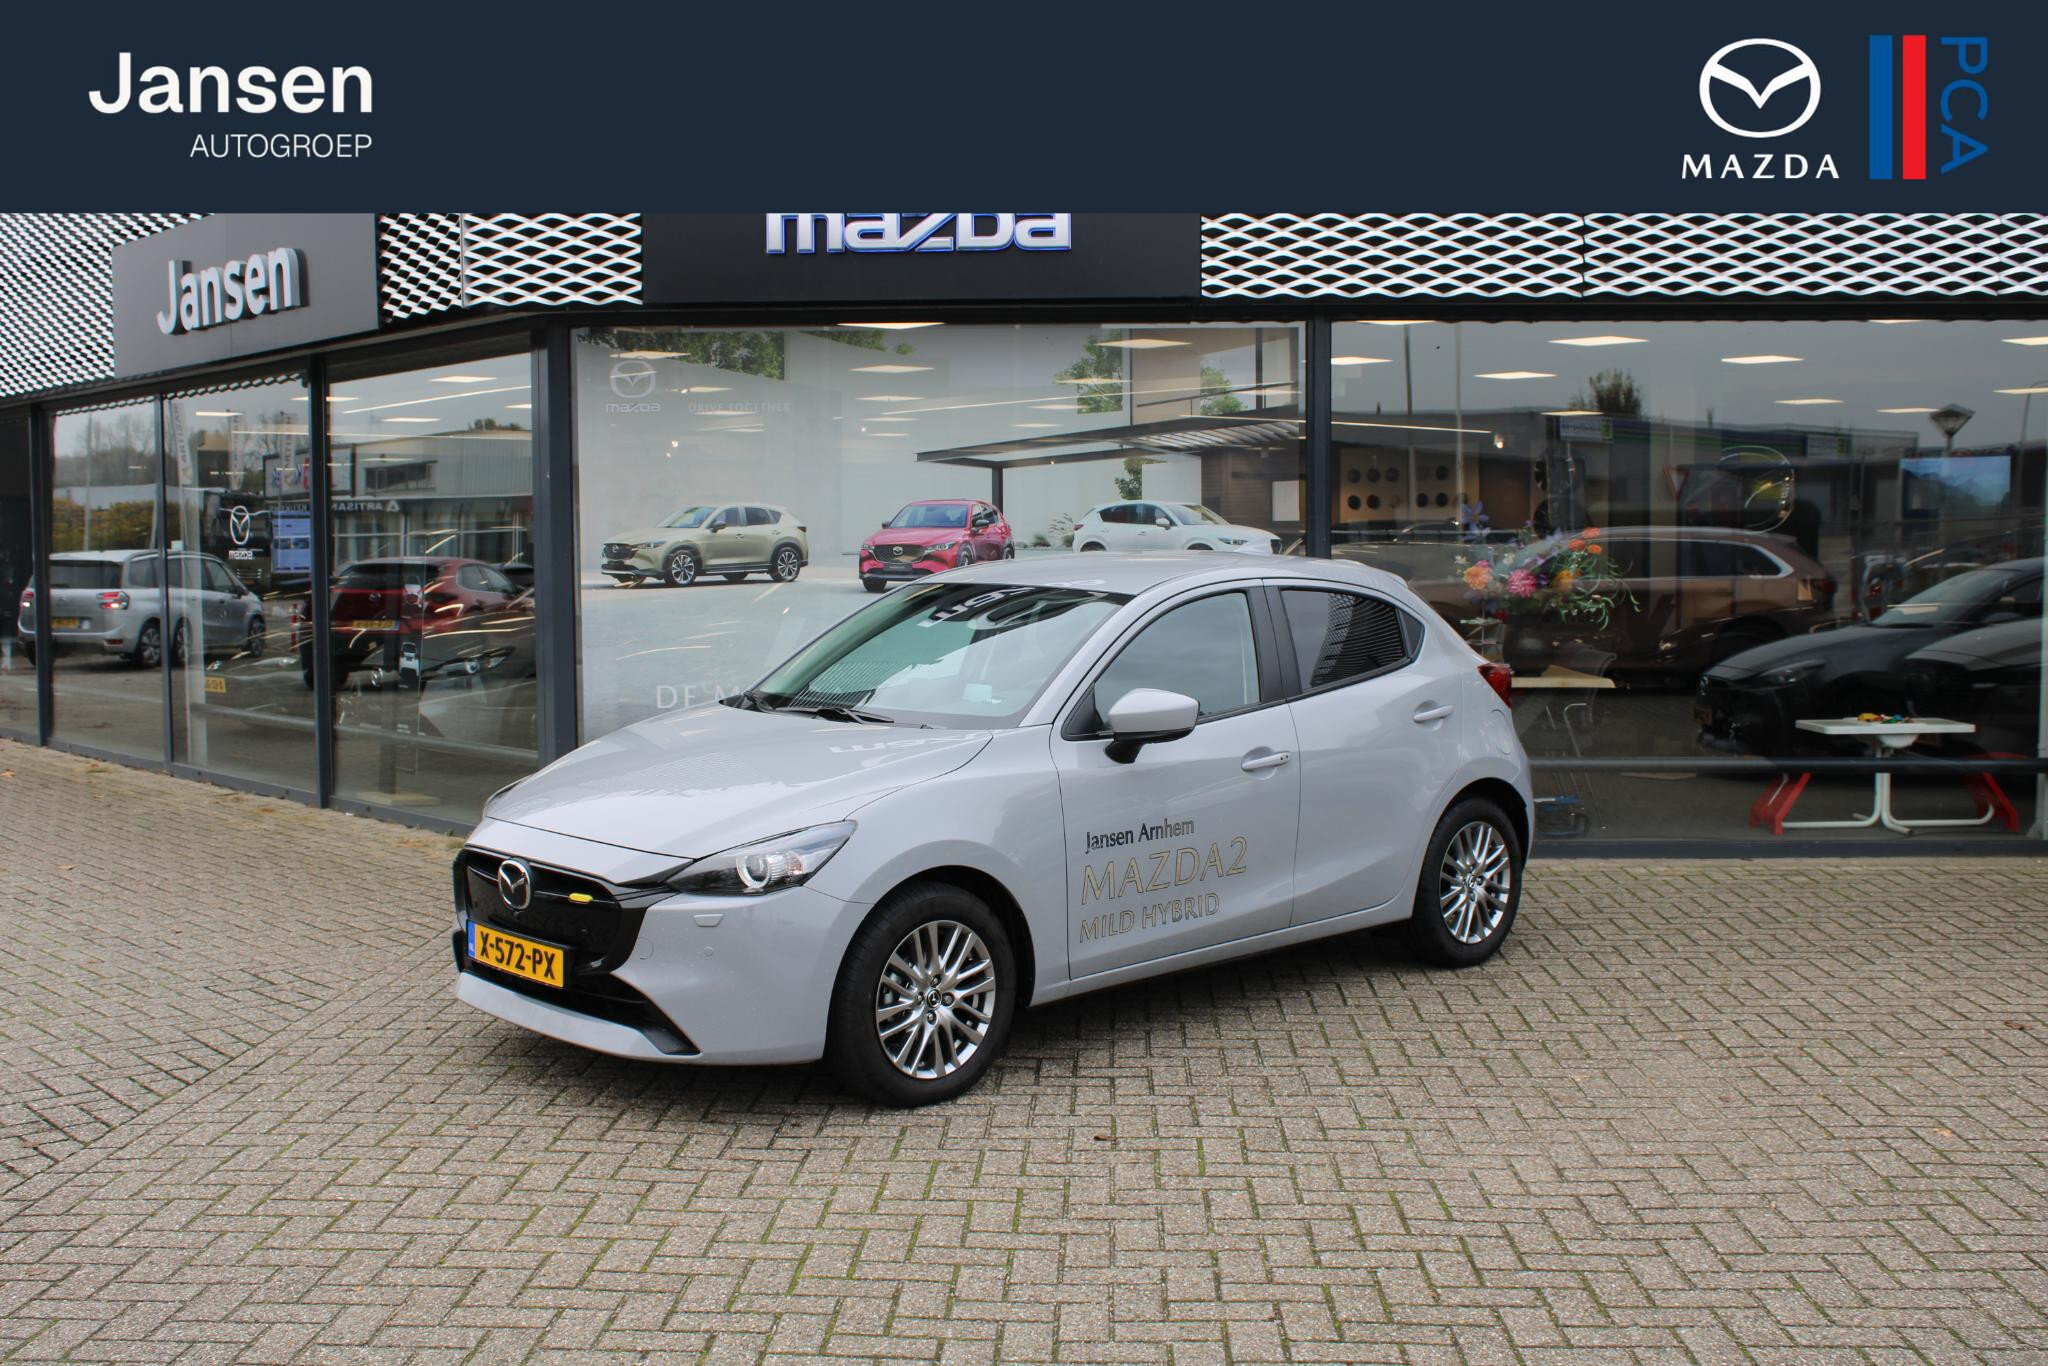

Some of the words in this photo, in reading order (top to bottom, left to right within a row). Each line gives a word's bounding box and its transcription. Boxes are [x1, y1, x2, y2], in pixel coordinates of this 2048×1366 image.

[157, 246, 303, 336] Jansen
[1085, 831, 1135, 855] Jansen
[1138, 817, 1195, 843] Arnhem
[1081, 836, 1248, 906] MAZDA2
[1079, 909, 1135, 944] MILD
[1141, 892, 1220, 929] HYBRID
[479, 930, 556, 981] X-572-PX
